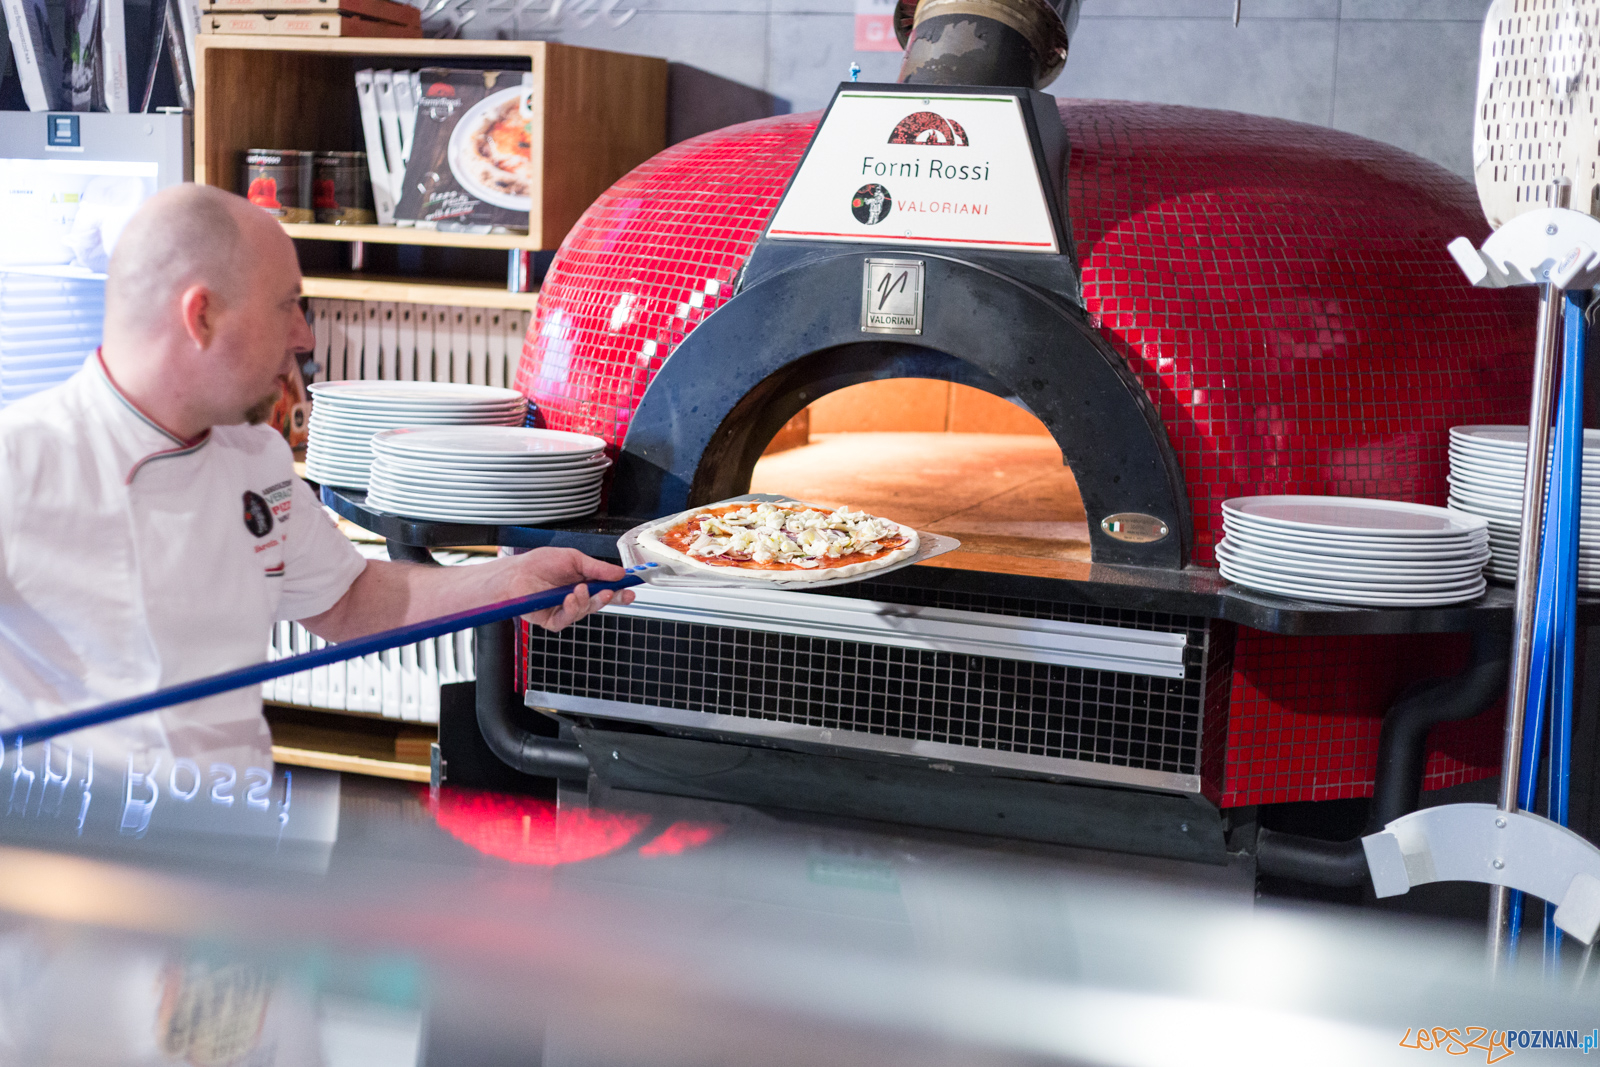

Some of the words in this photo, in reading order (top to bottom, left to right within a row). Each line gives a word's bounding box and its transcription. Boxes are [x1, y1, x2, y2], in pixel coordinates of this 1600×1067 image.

[862, 156, 920, 179] Forni
[929, 158, 989, 181] Rossi
[897, 200, 989, 215] VALORIANI
[869, 315, 914, 326] VALORIANI
